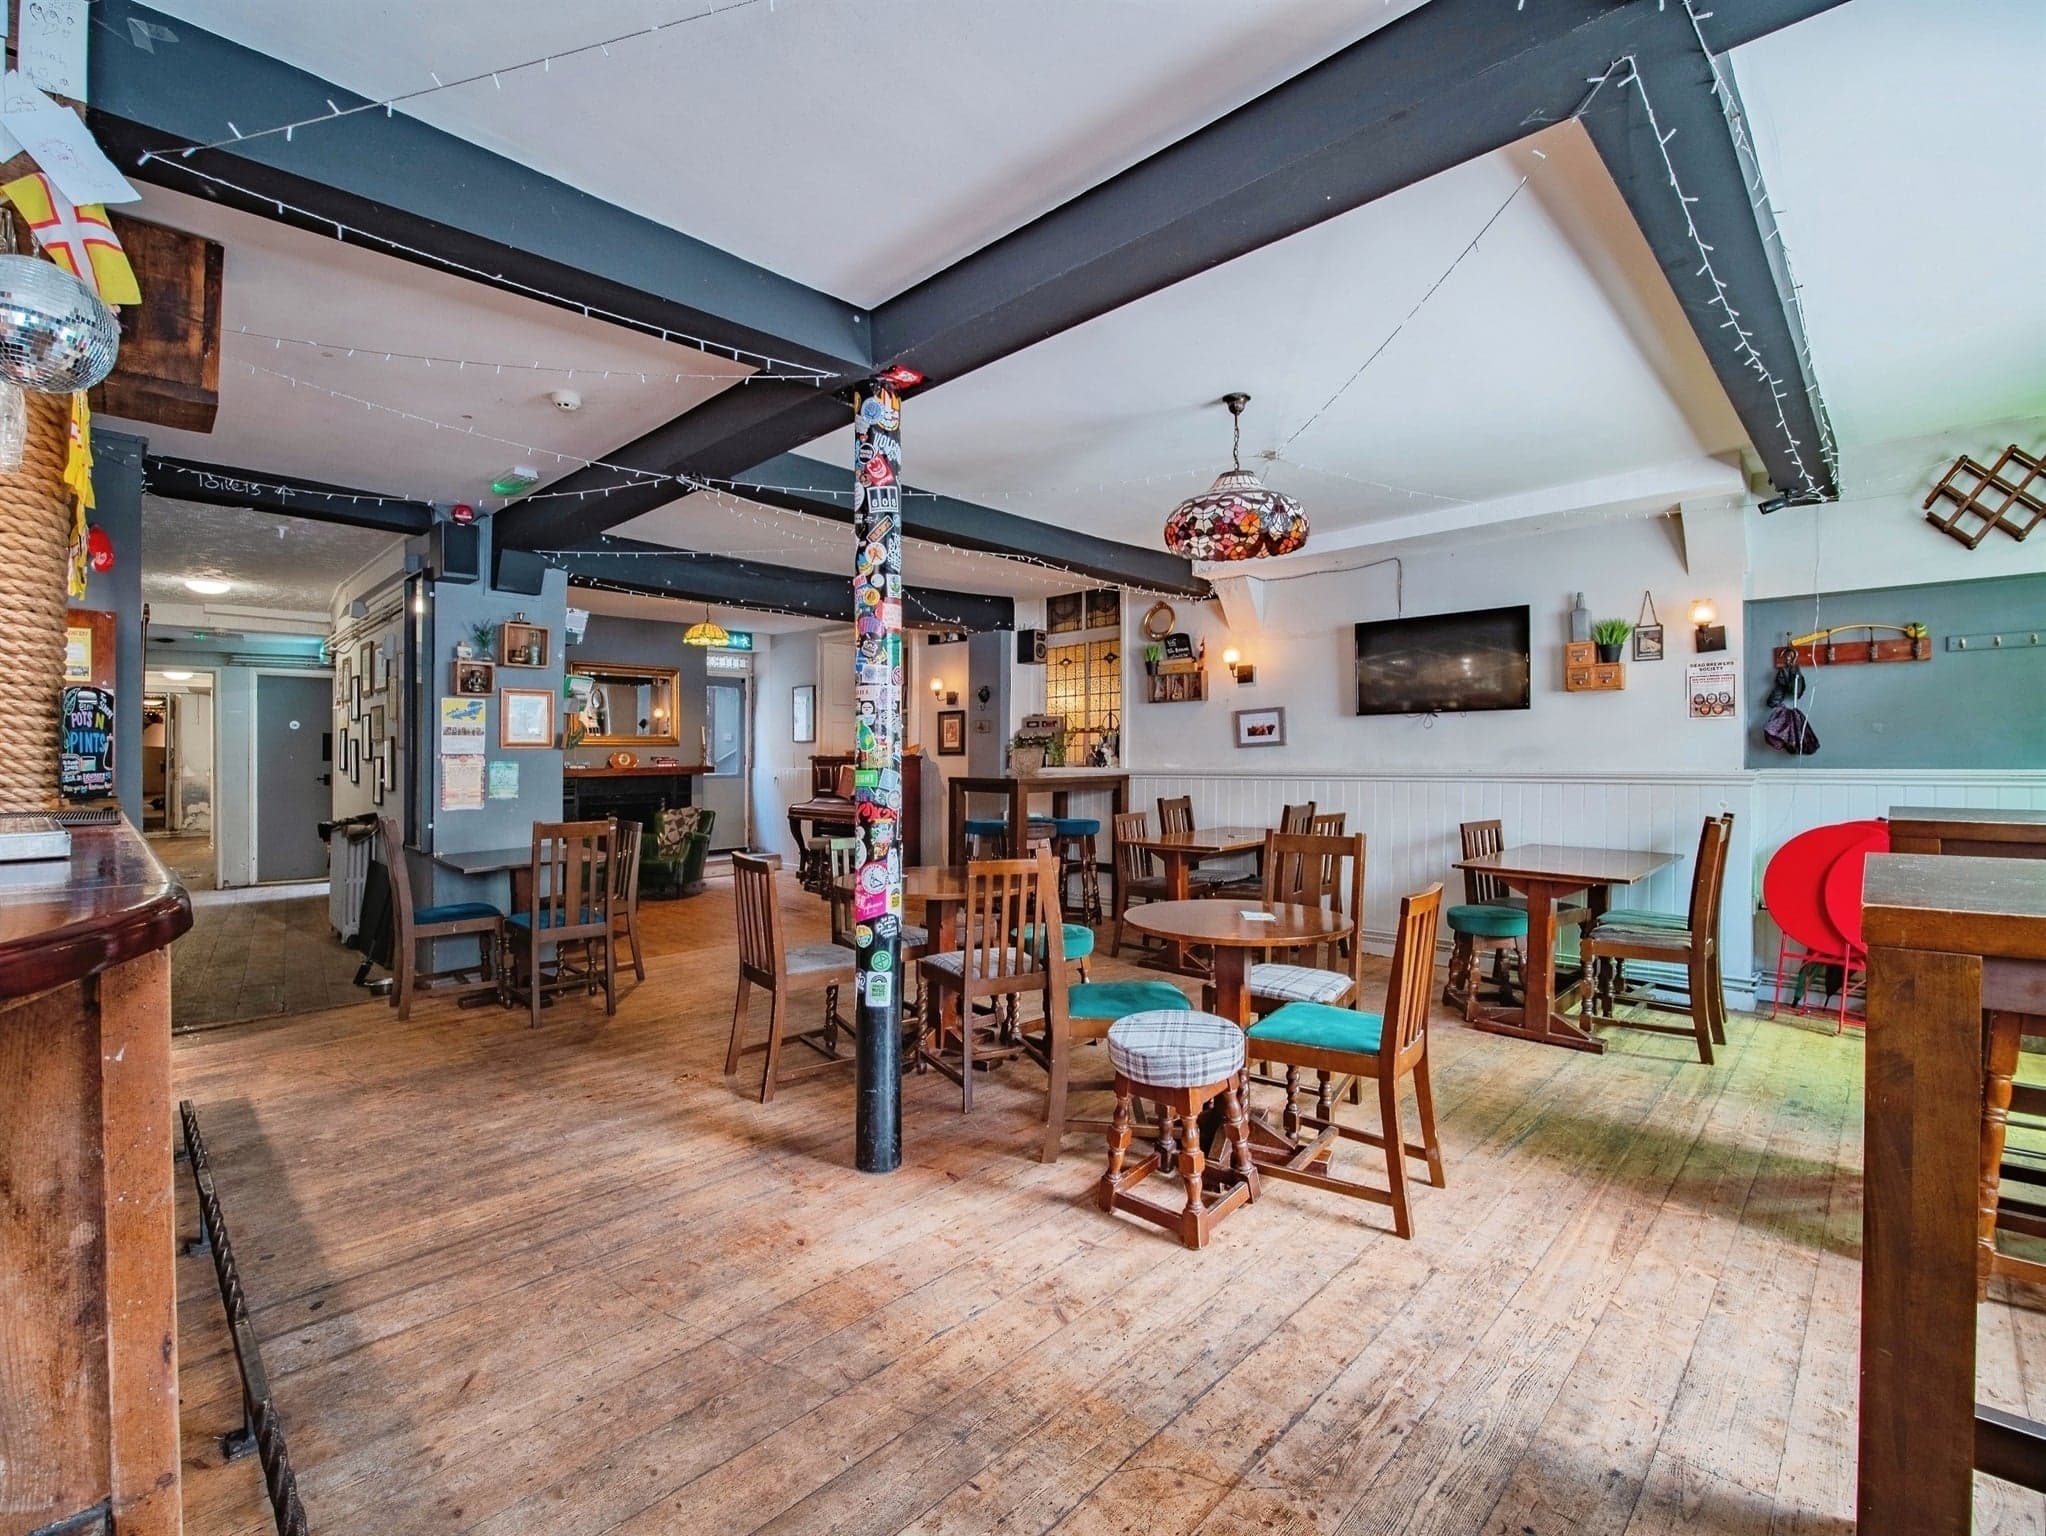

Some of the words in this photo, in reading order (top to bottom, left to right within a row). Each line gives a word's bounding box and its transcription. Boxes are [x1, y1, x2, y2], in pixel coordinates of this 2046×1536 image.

[71, 711, 93, 728] POTS
[95, 711, 105, 730] N
[69, 731, 106, 754] PINTS
